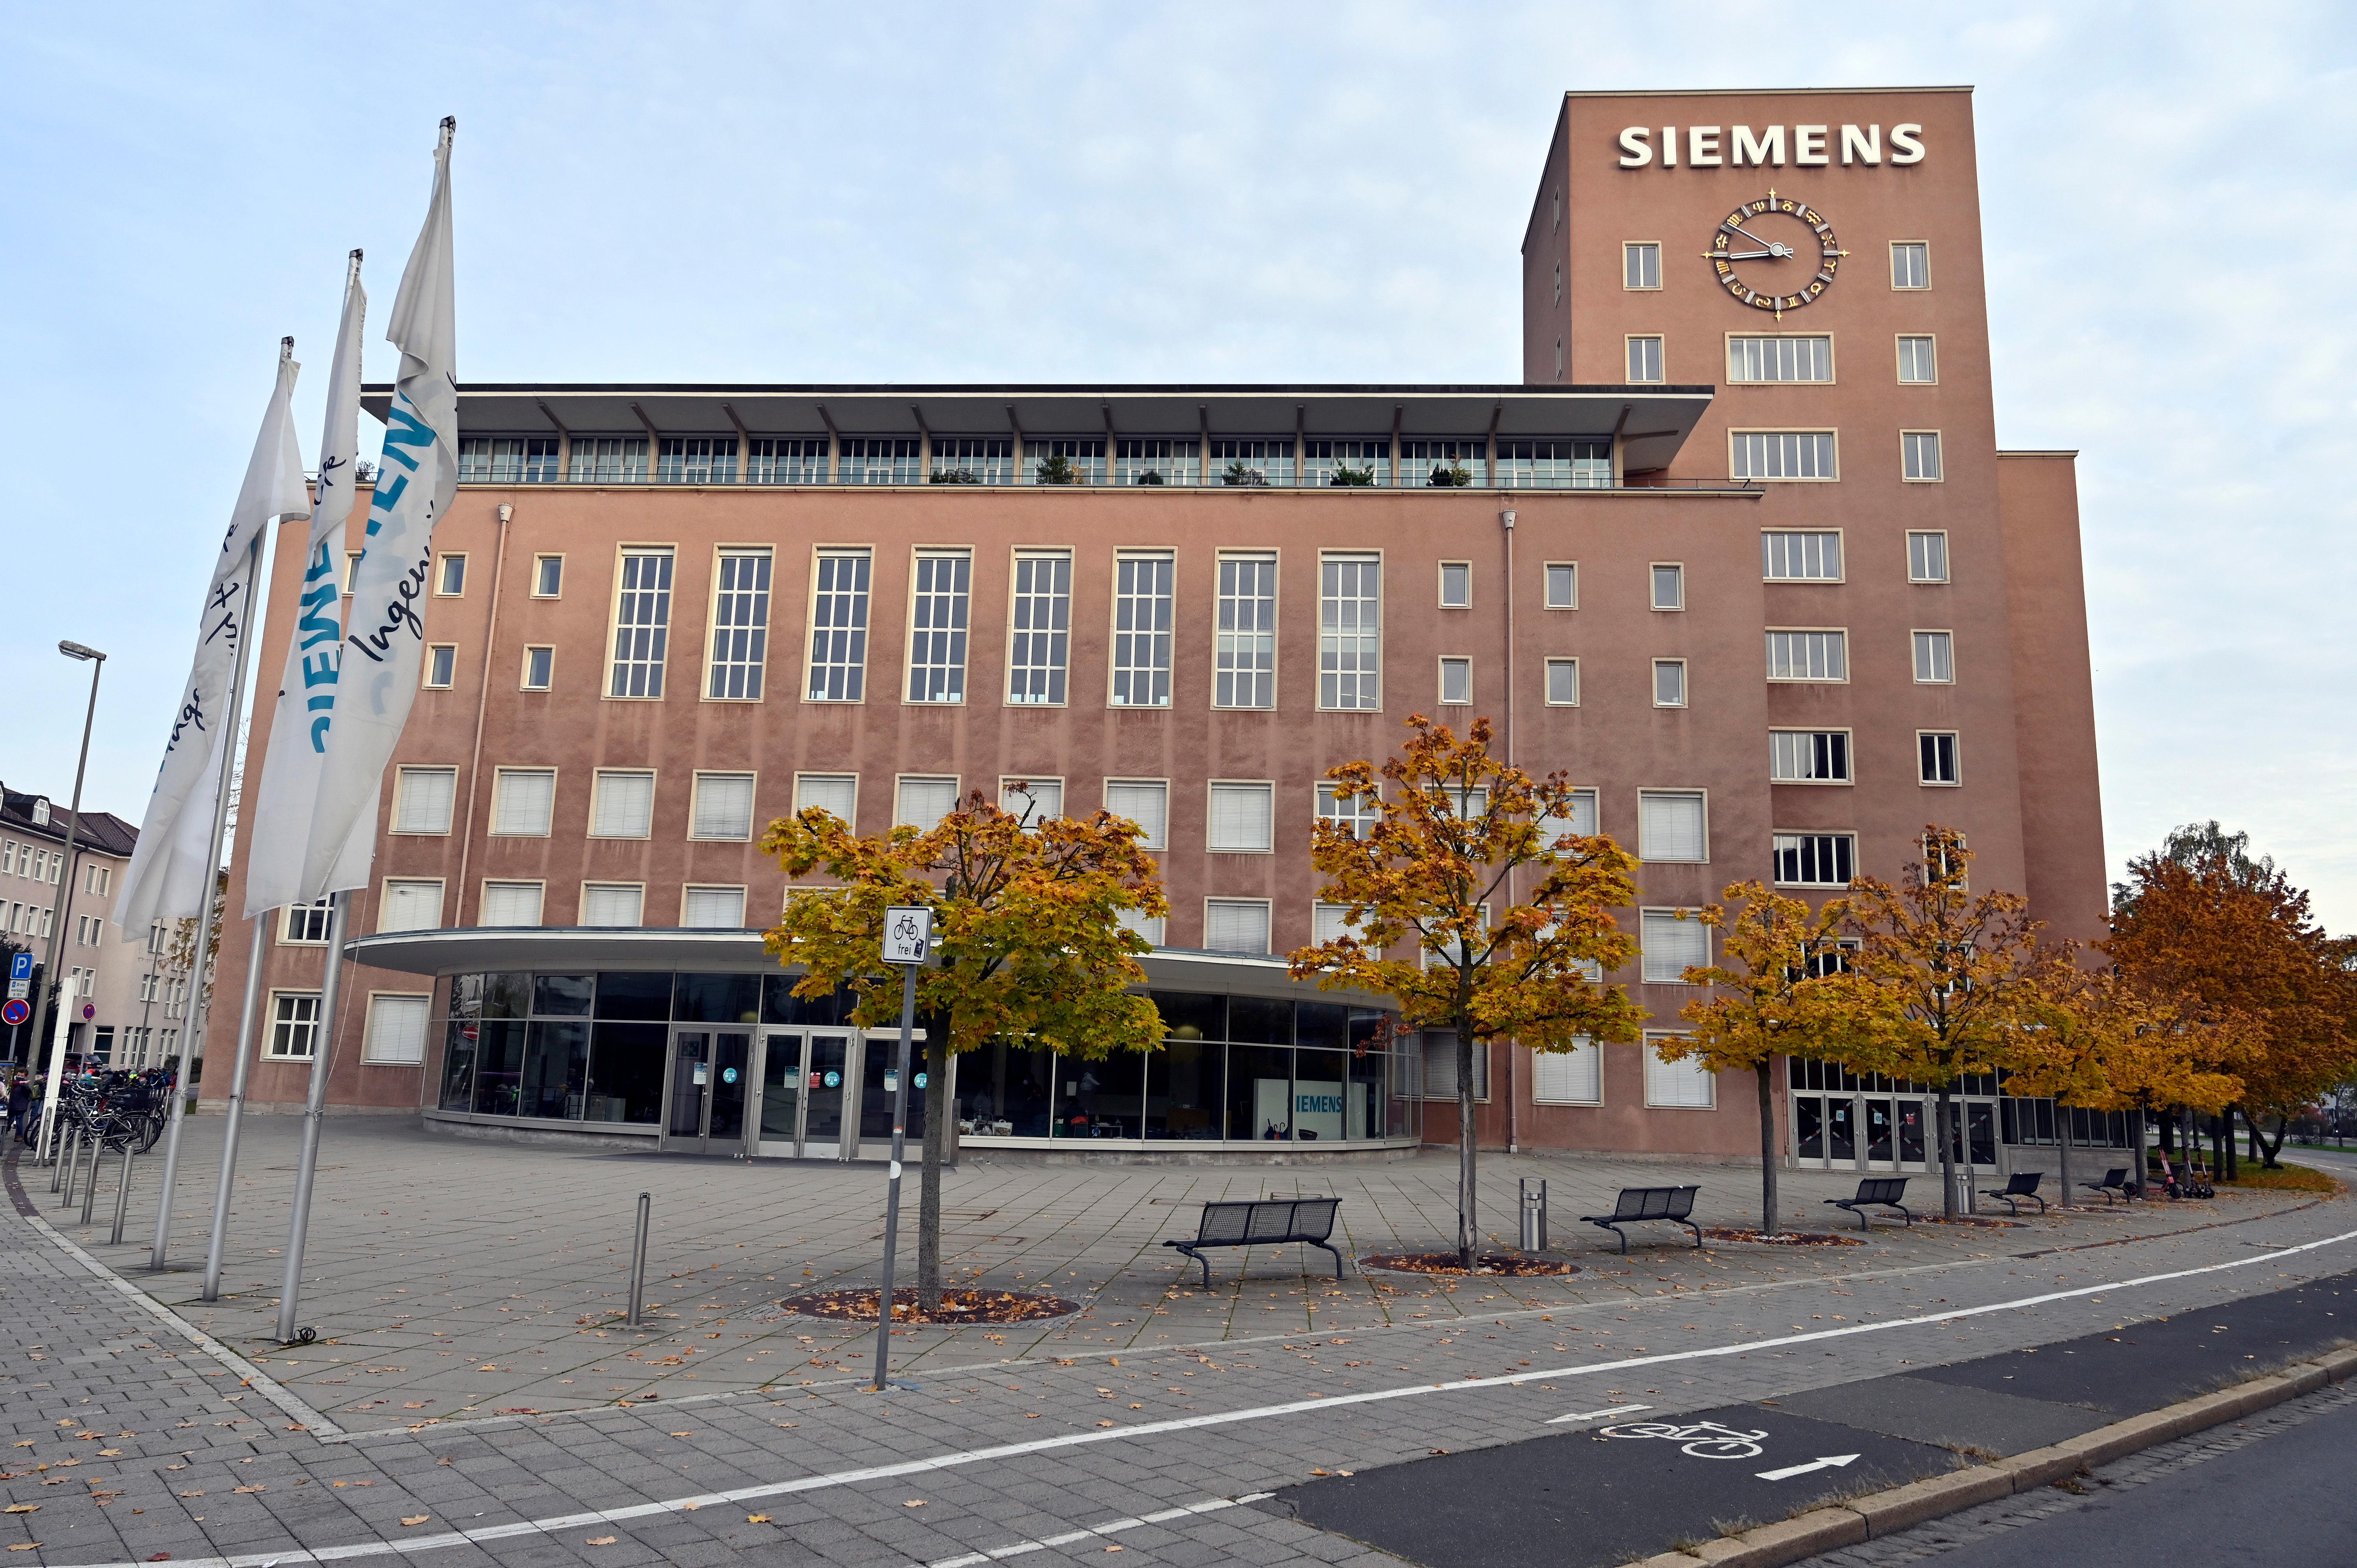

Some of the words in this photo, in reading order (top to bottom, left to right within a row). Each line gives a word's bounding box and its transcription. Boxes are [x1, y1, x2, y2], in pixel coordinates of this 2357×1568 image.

[1618, 123, 1926, 168] SIEMENS
[348, 500, 434, 662] Ingen
[898, 943, 911, 955] frei
[16, 957, 27, 975] P
[1296, 1095, 1342, 1113] IEMENS
